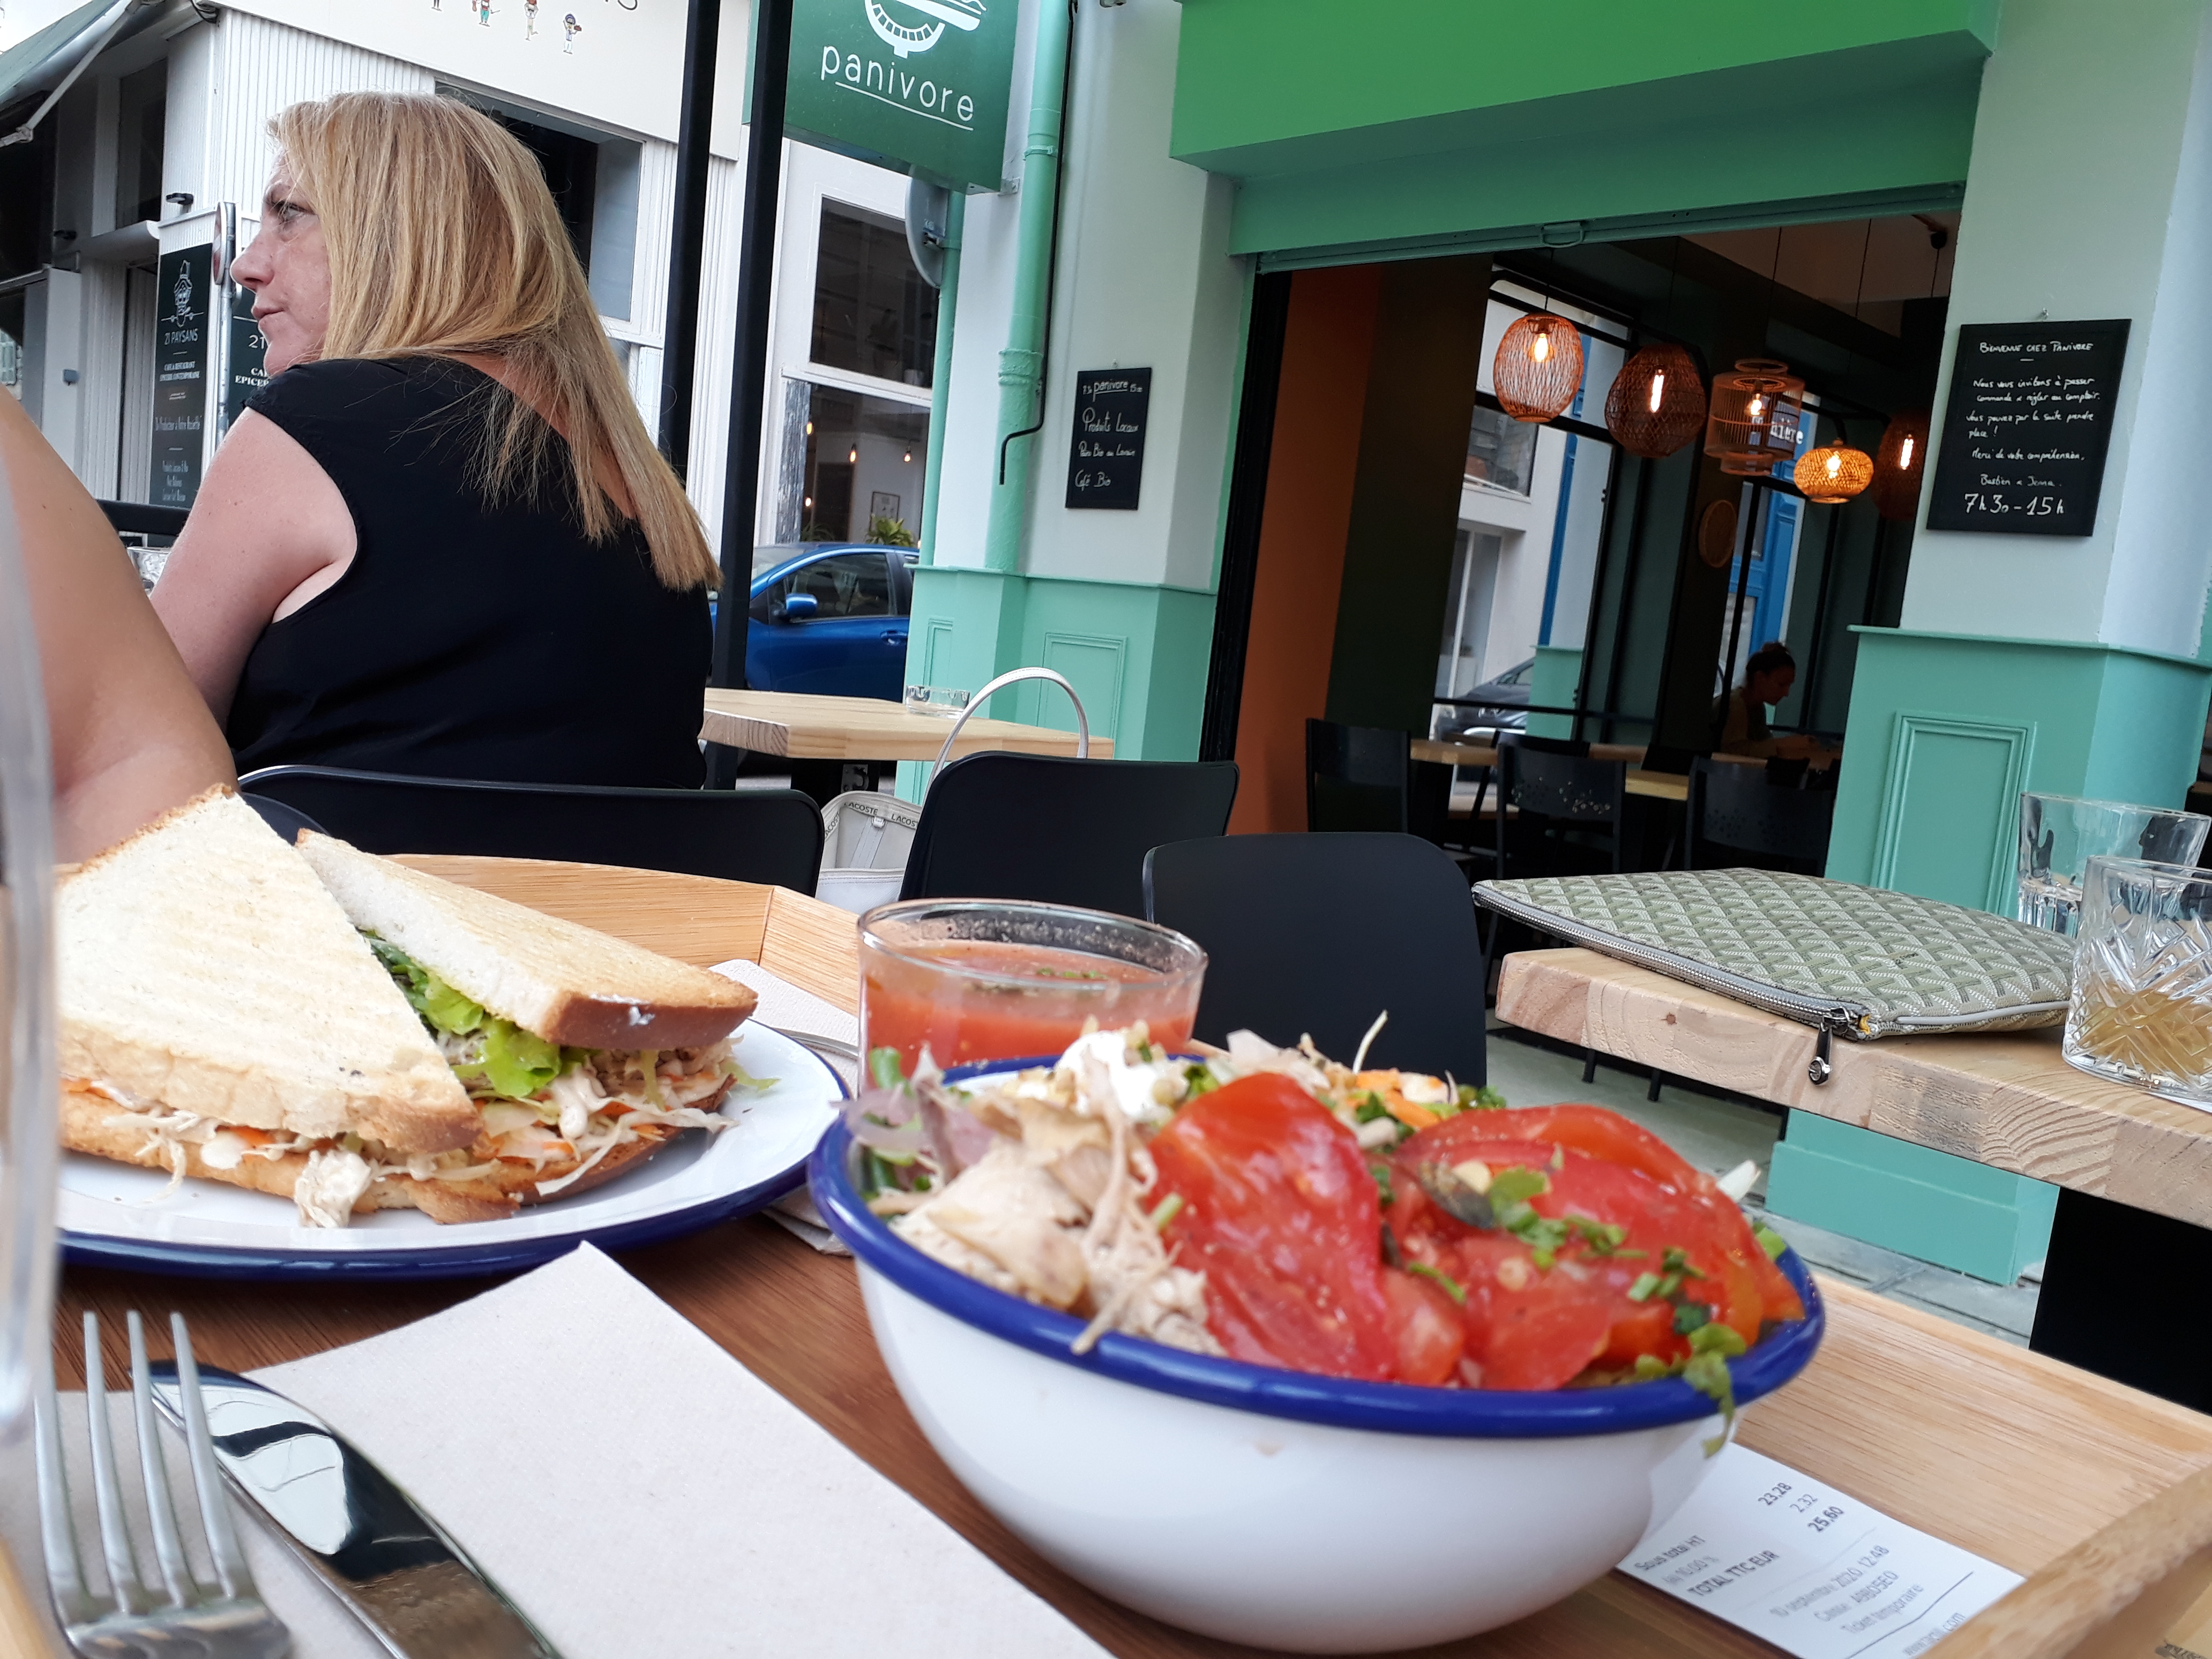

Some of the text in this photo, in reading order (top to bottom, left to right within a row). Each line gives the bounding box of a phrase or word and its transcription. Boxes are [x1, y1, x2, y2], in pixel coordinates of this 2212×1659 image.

[820, 45, 974, 121] panivore
[249, 334, 265, 349] 21
[844, 802, 878, 815] ACOSTE
[1687, 1574, 1733, 1596] TOTAL
[1750, 1550, 1779, 1566] EUR
[1808, 1506, 1844, 1532] 25.60
